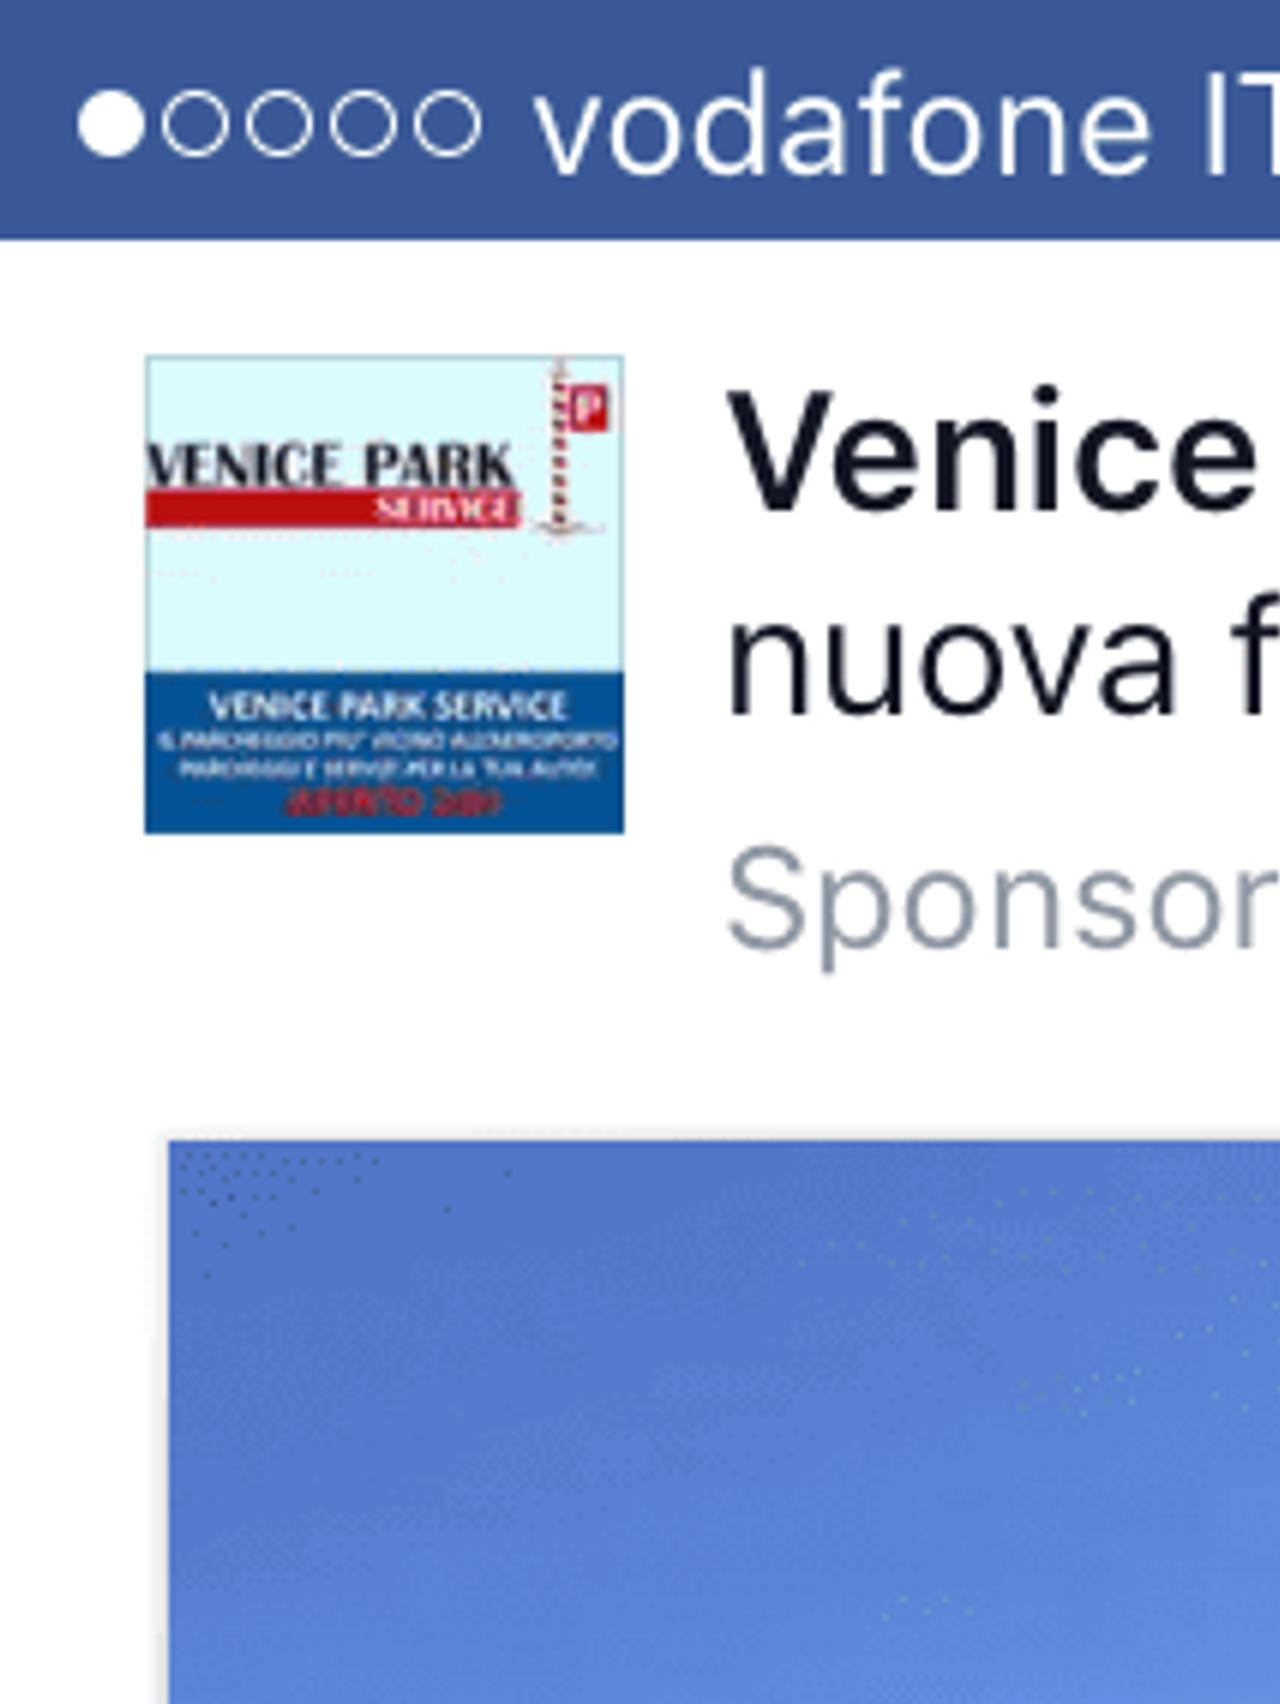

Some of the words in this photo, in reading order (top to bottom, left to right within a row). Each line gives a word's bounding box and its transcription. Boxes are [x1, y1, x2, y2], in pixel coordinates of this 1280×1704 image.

[532, 66, 1152, 178] vodafone
[146, 440, 343, 488] VENICE
[364, 440, 517, 488] PARK
[724, 382, 1258, 515] Venice
[208, 688, 331, 722] VENICE
[340, 688, 428, 722] PARK
[434, 688, 568, 722] SERVICE
[730, 622, 1176, 719] nuova
